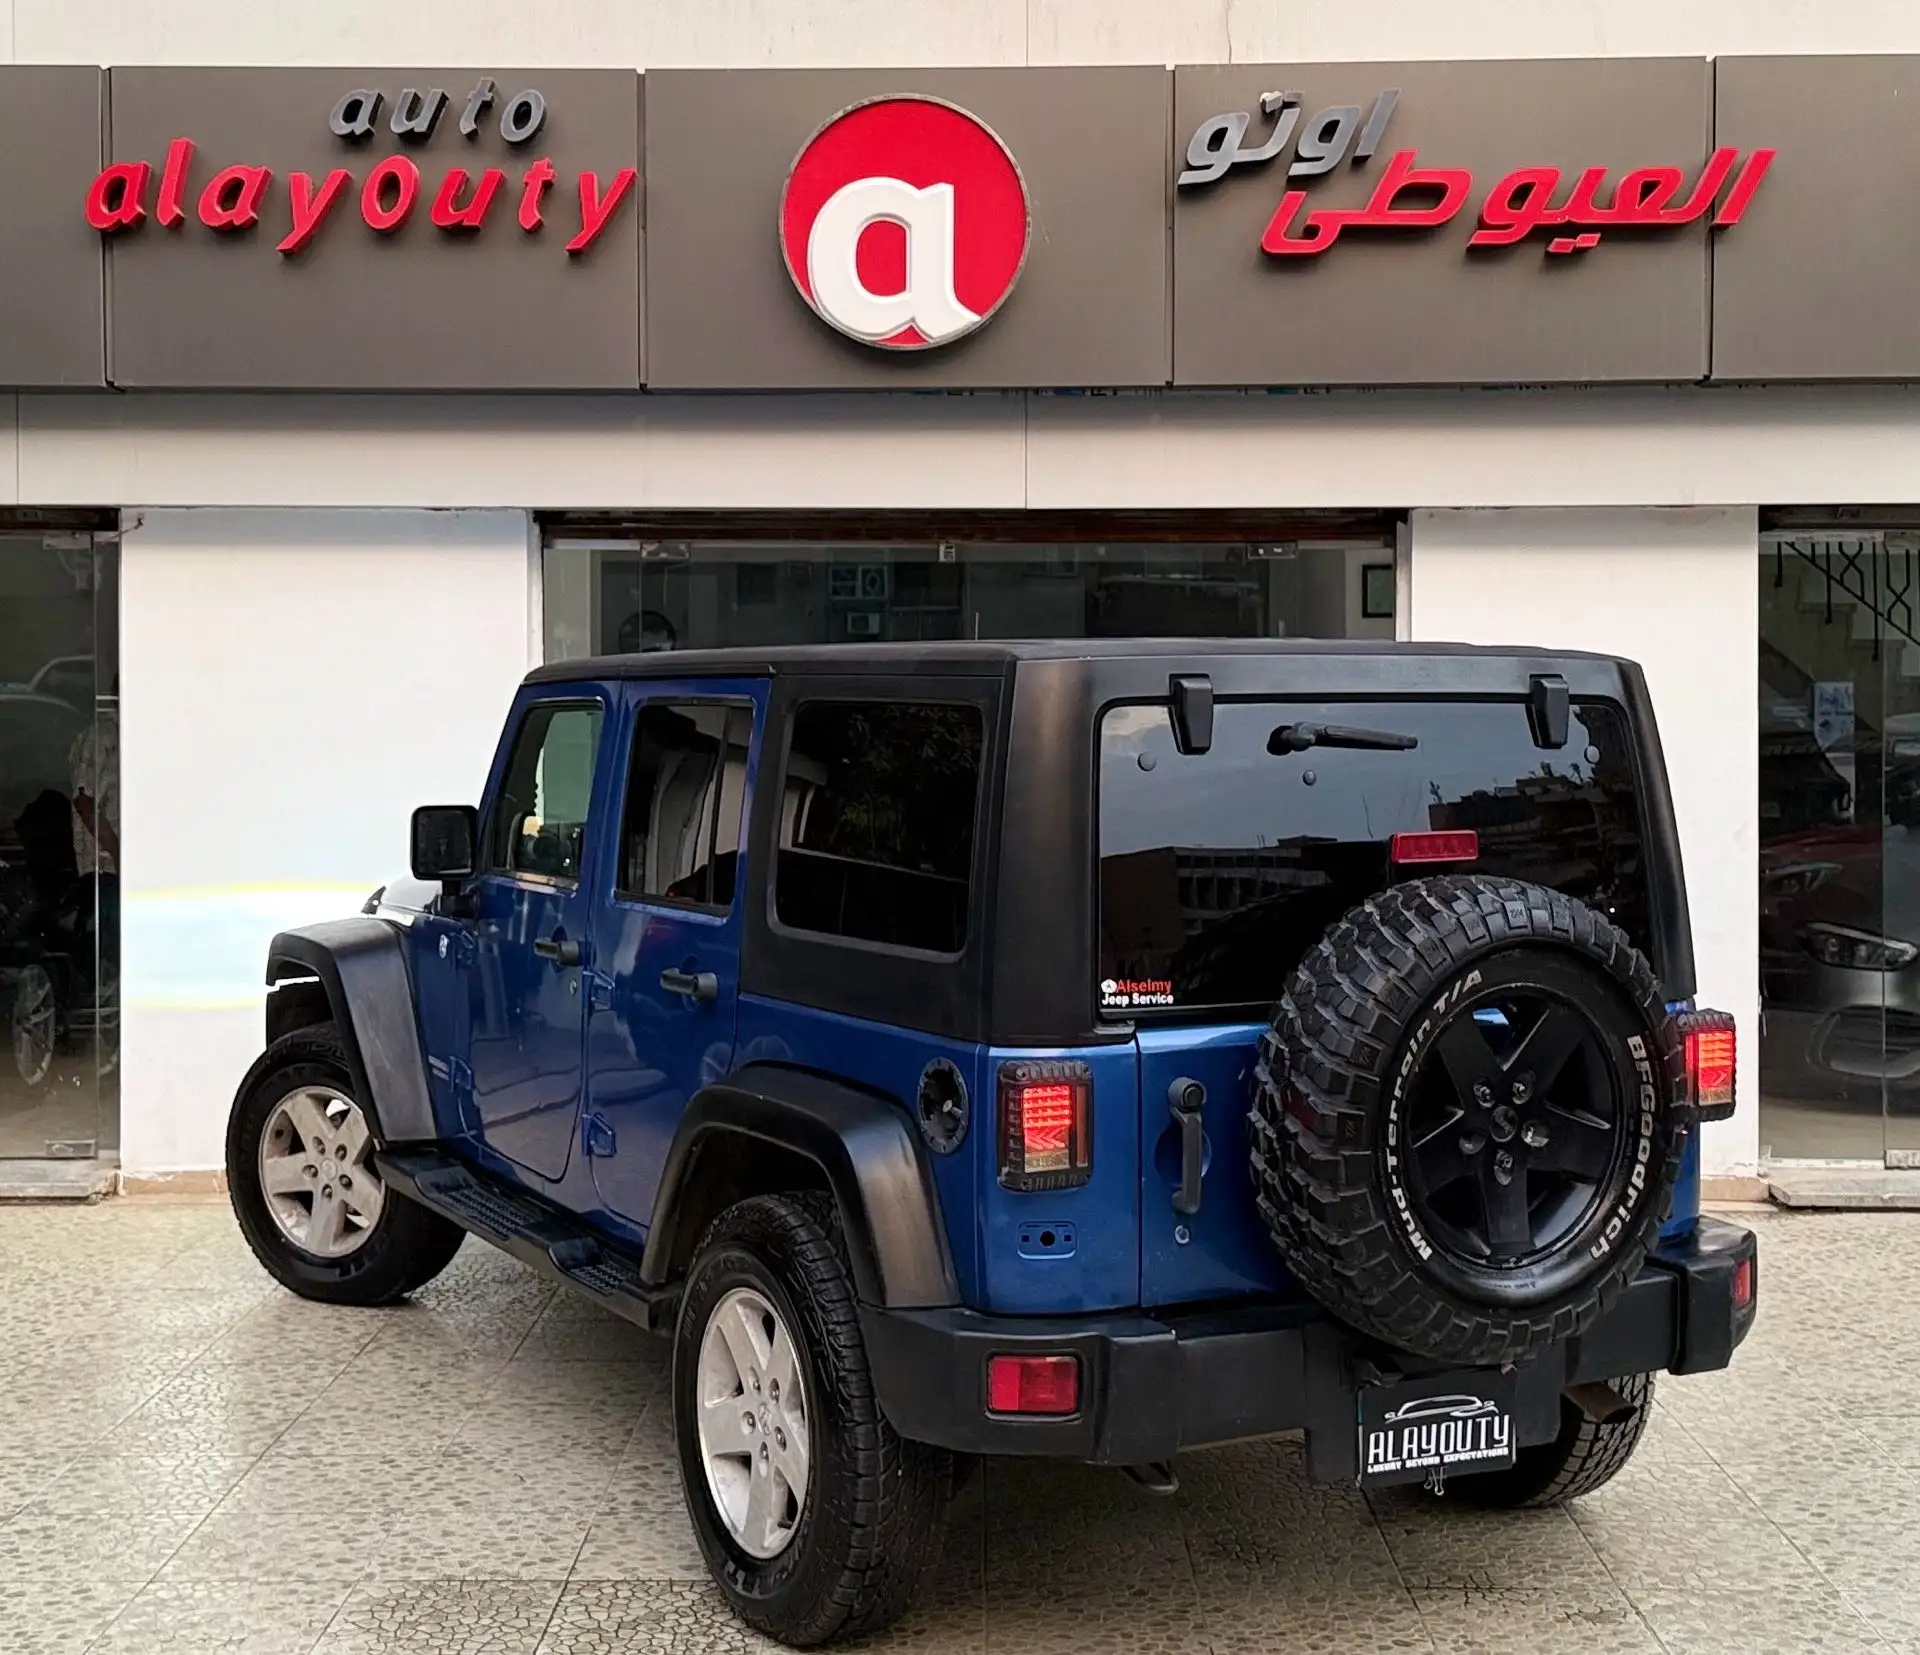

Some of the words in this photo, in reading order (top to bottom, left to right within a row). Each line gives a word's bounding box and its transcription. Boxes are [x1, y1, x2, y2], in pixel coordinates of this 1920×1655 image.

[329, 77, 547, 143] auto
[807, 176, 982, 342] a
[1101, 993, 1129, 1007] Jeep
[1132, 992, 1174, 1005] Service
[1116, 979, 1172, 994] Alselmy
[1433, 969, 1483, 1015] T/A
[1590, 1034, 1656, 1260] BFGoodrich
[1367, 1414, 1510, 1465] ALAYOUTY
[1367, 1460, 1402, 1474] LUXURY
[1405, 1456, 1441, 1469] BEYOND
[1443, 1446, 1509, 1464] EXPECTATIONS
